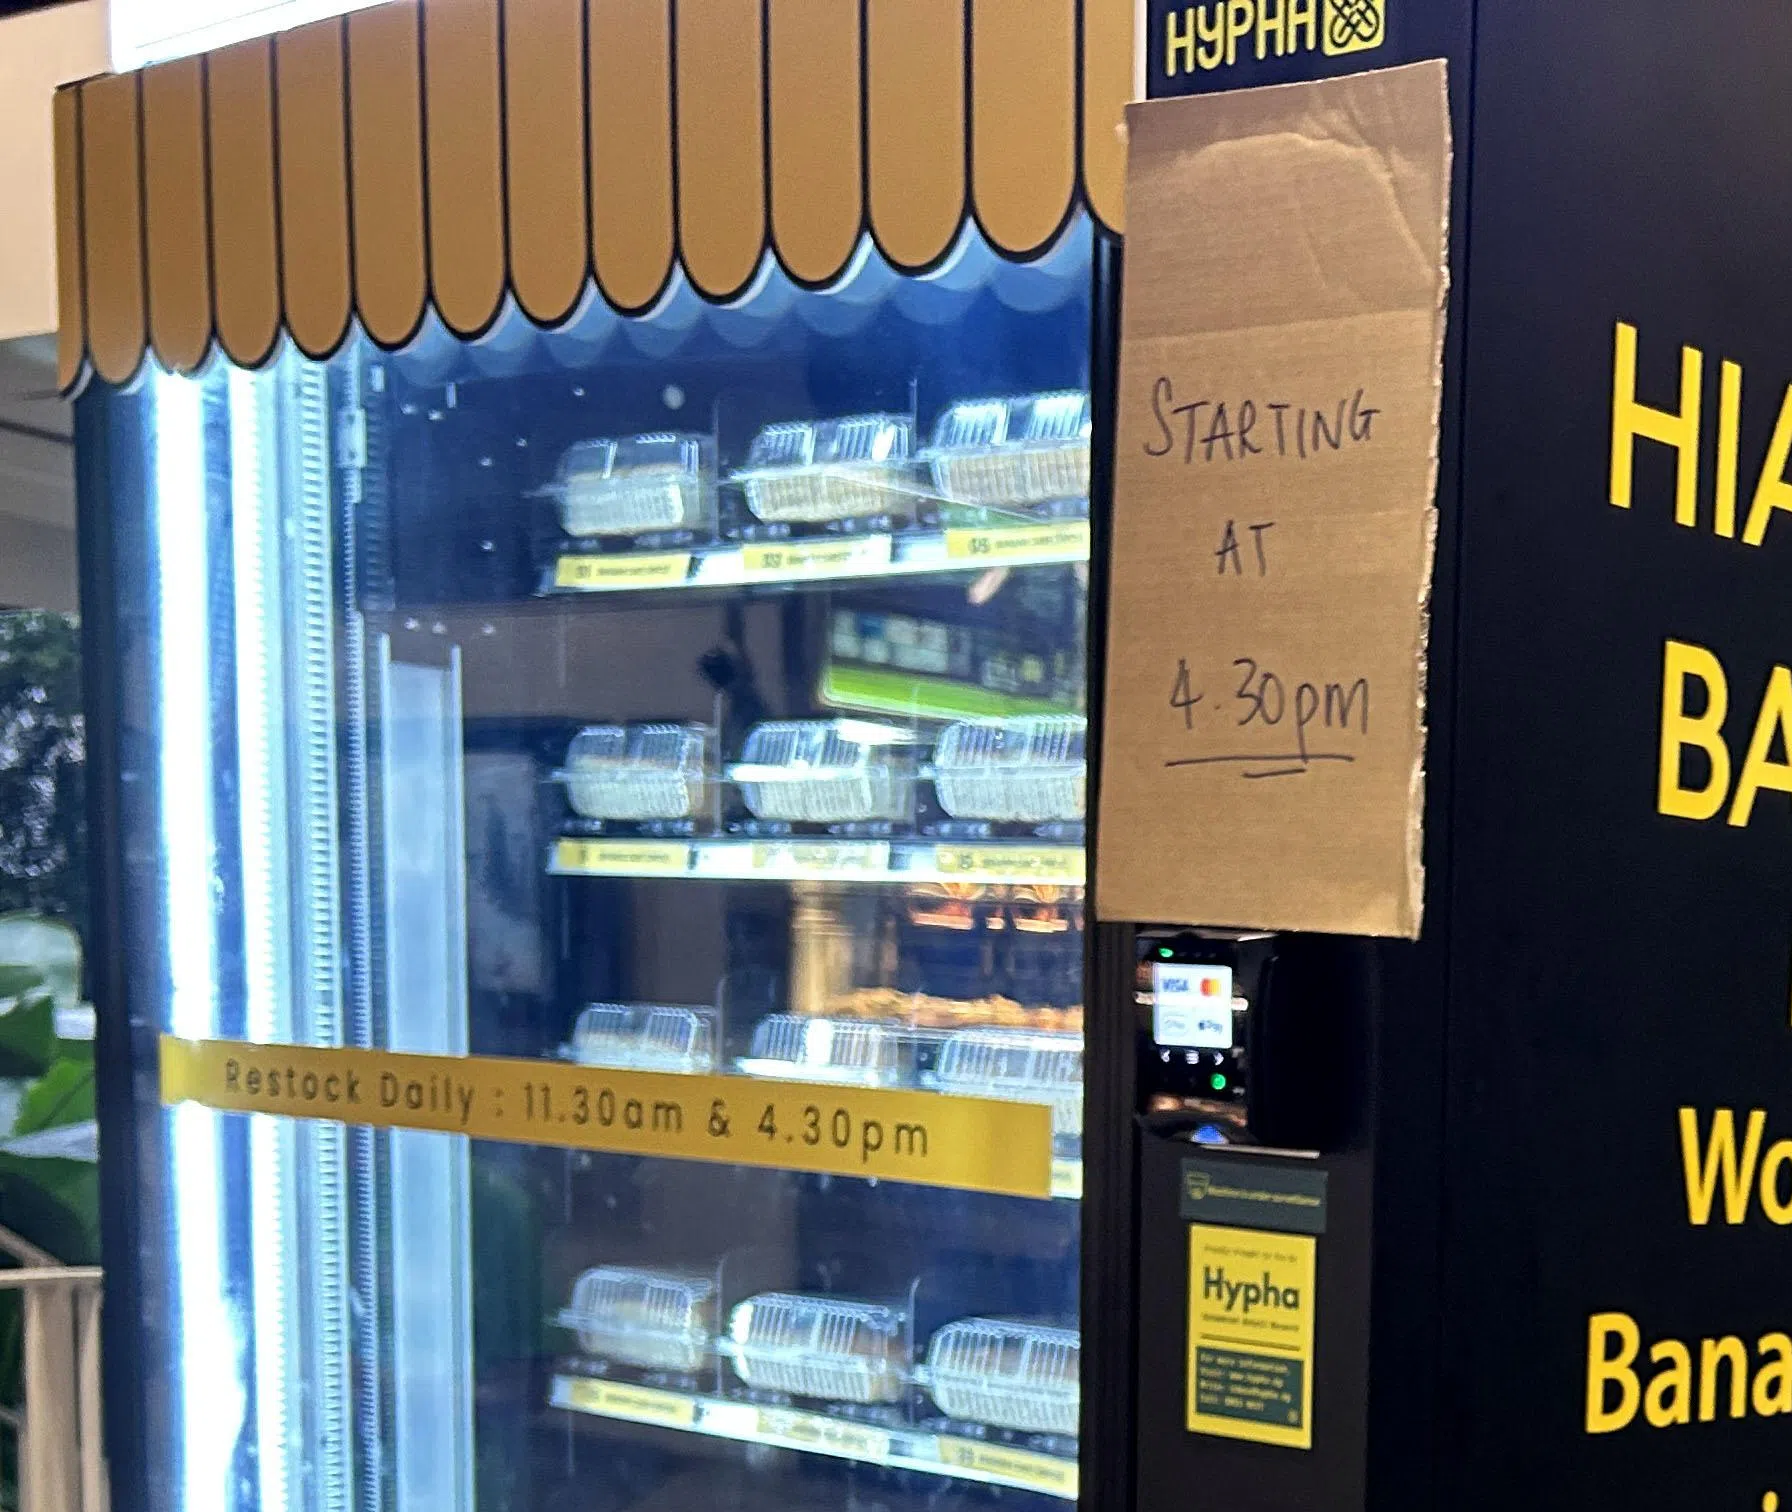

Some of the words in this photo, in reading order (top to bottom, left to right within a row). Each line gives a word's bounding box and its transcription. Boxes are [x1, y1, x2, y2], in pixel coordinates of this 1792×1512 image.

[1144, 376, 1380, 464] STARTING
[1215, 520, 1276, 577] AT
[1169, 657, 1369, 763] 4.30pm
[225, 1058, 361, 1104] Restock
[379, 1071, 474, 1124] Daily
[523, 1082, 683, 1133] 11.30am
[708, 1100, 730, 1138] &
[758, 1103, 928, 1164] 4.30pm
[1203, 1265, 1300, 1313] Hypha
